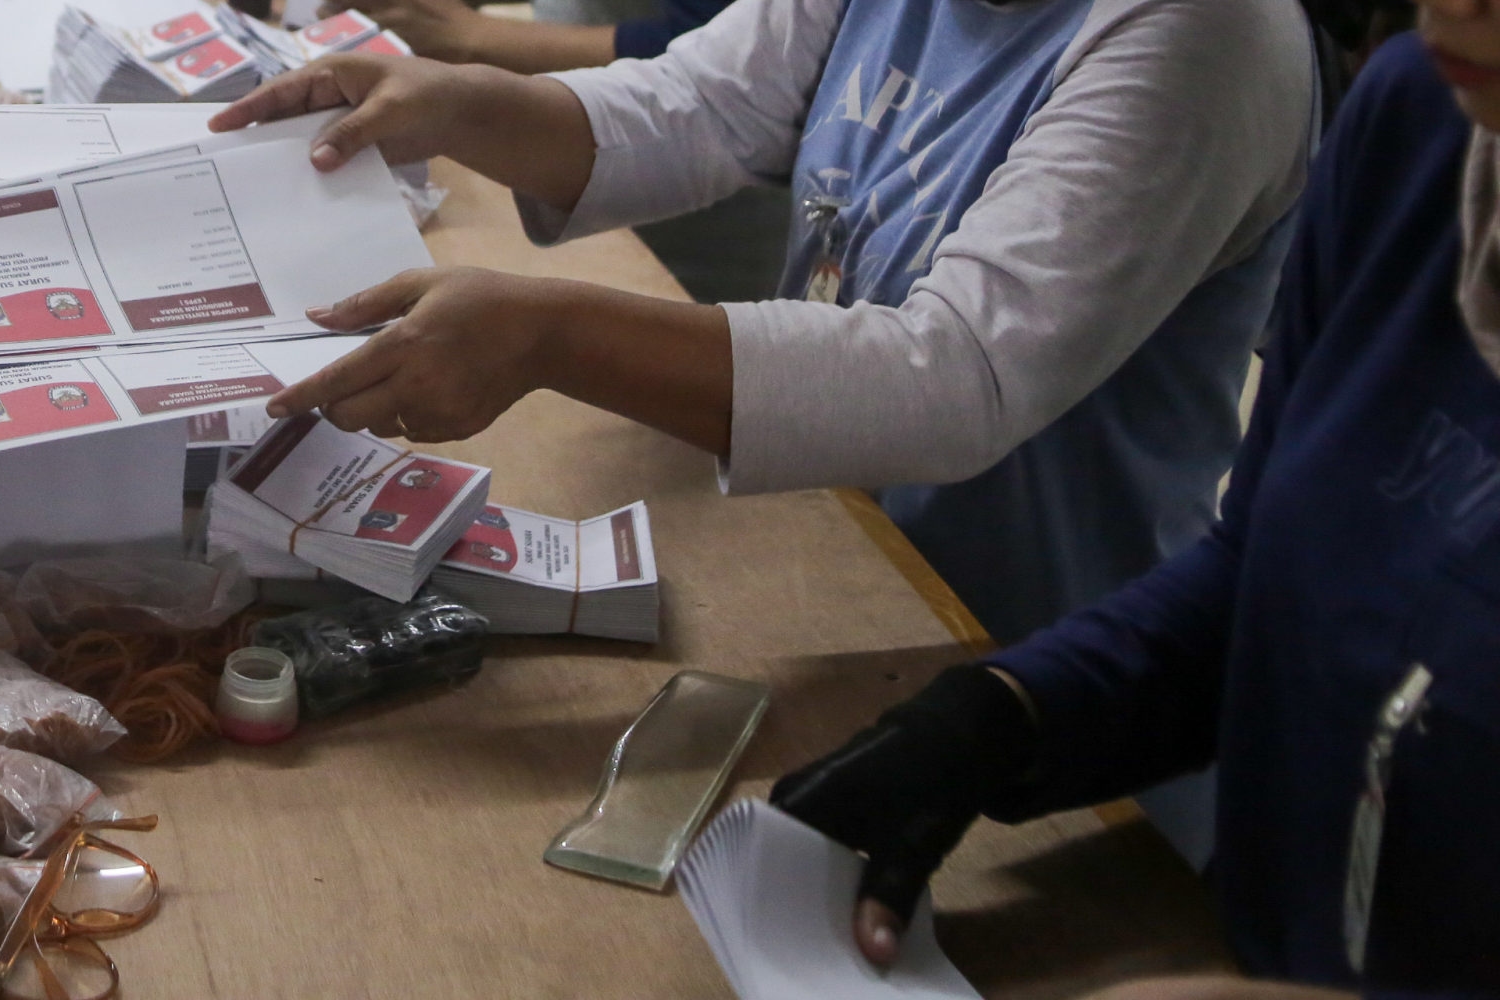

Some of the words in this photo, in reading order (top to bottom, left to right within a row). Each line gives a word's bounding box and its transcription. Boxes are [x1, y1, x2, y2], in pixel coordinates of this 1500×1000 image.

[12, 255, 49, 265] PROVINSI
[16, 276, 51, 286] SURAT
[183, 297, 202, 305] KPPS
[183, 300, 233, 311] PEMUNGUTAN
[209, 305, 249, 316] KELOMPOK
[149, 310, 209, 322] PENYELENGGARA
[16, 374, 52, 383] SURAT
[167, 390, 195, 398] SUARA
[222, 386, 264, 396] KELOMPOK
[157, 392, 223, 406] PENYELENGGARA
[342, 491, 367, 514] SUARA
